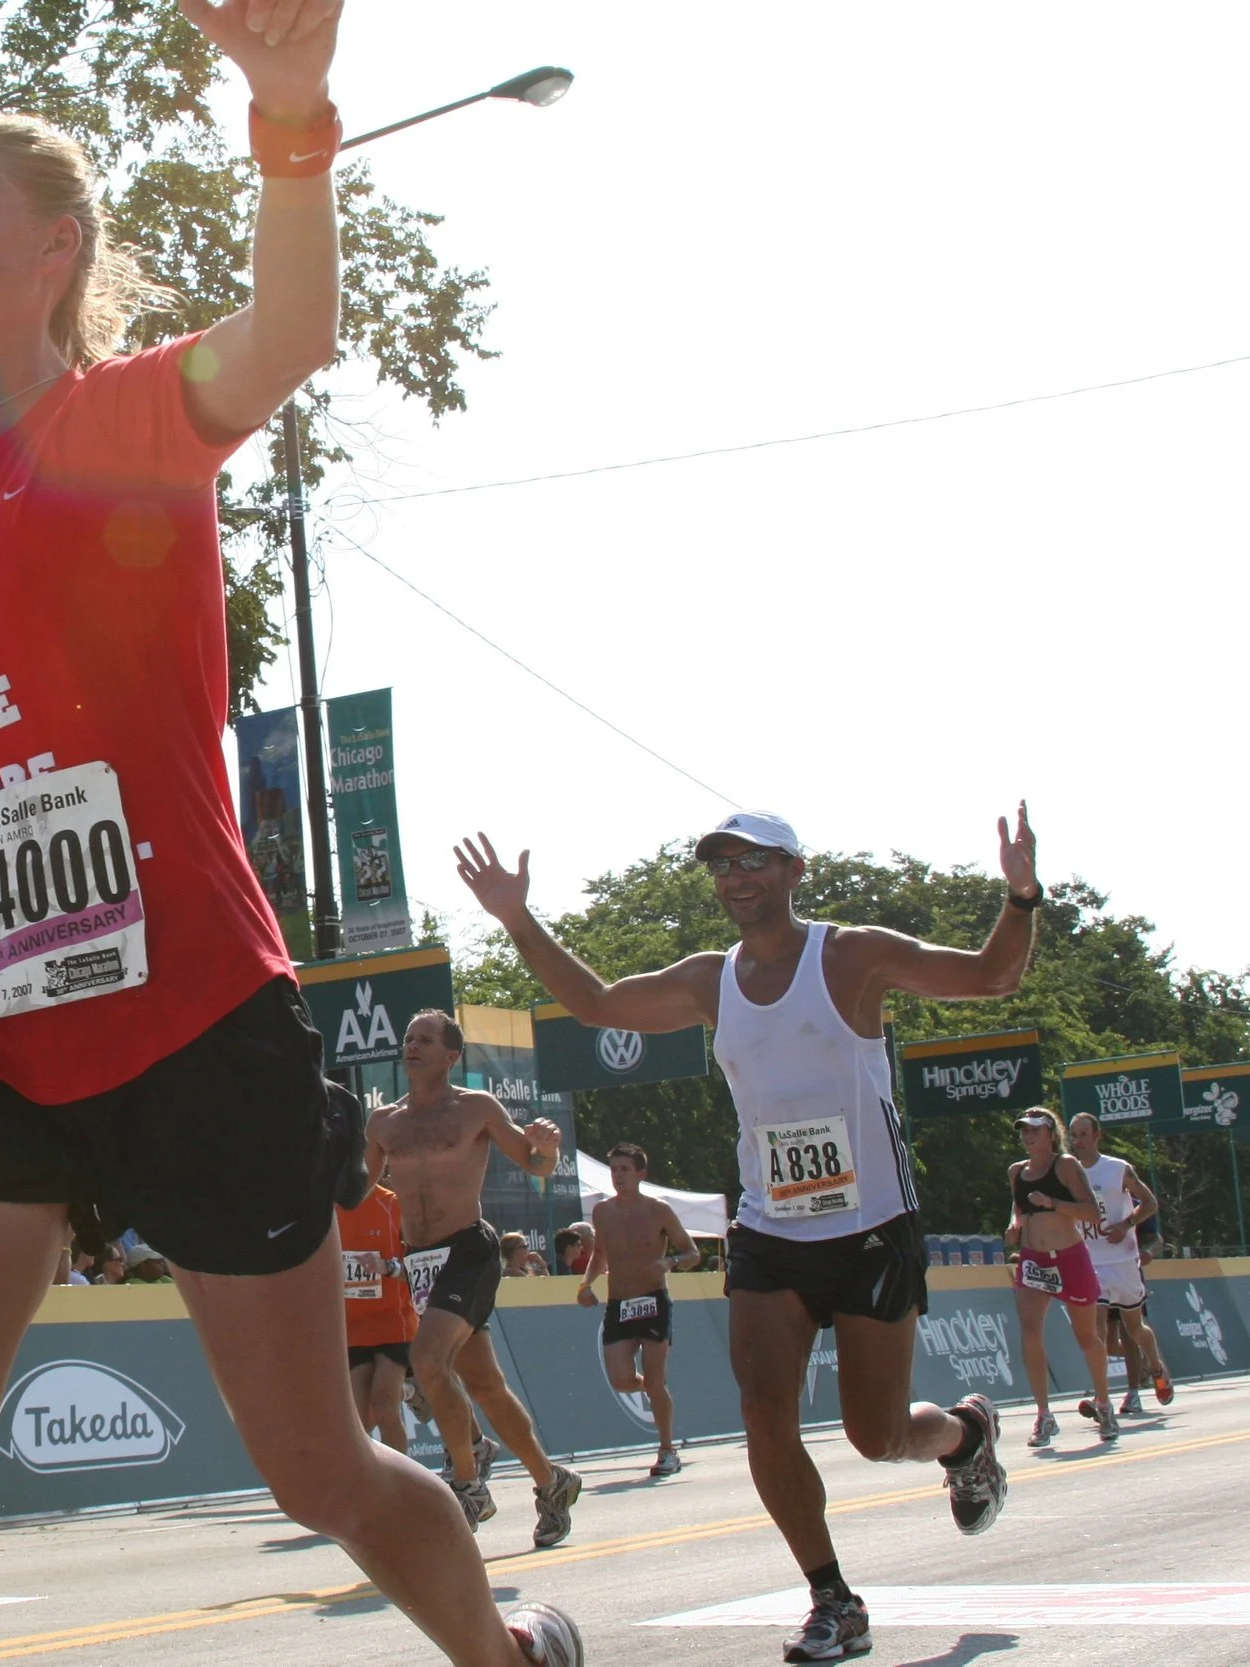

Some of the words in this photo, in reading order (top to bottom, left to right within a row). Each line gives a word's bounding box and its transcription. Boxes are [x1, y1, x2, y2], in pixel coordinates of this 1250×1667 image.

[330, 745, 383, 768] Chicago
[41, 786, 88, 813] Bank
[6, 825, 34, 843] AMRO
[7, 906, 128, 962] ANNIVERSARY
[1, 988, 12, 1002] 7,
[12, 983, 33, 998] 2007
[69, 976, 119, 992] ANNIVERSARY
[922, 1059, 1022, 1089] Hinckley
[488, 1076, 531, 1101] LaSalle
[946, 1082, 997, 1100] Springs
[1095, 1078, 1151, 1099] WHOLE
[1100, 1094, 1150, 1114] FOODS
[778, 1129, 807, 1140] LaSalle
[809, 1125, 831, 1136] Bank
[770, 1148, 784, 1183] A
[786, 1141, 841, 1182] 838
[792, 1175, 848, 1195] ANNIVERSARY
[916, 1309, 1010, 1364] Hinckley
[949, 1354, 999, 1387] Springs
[24, 1401, 155, 1448] Takeda
